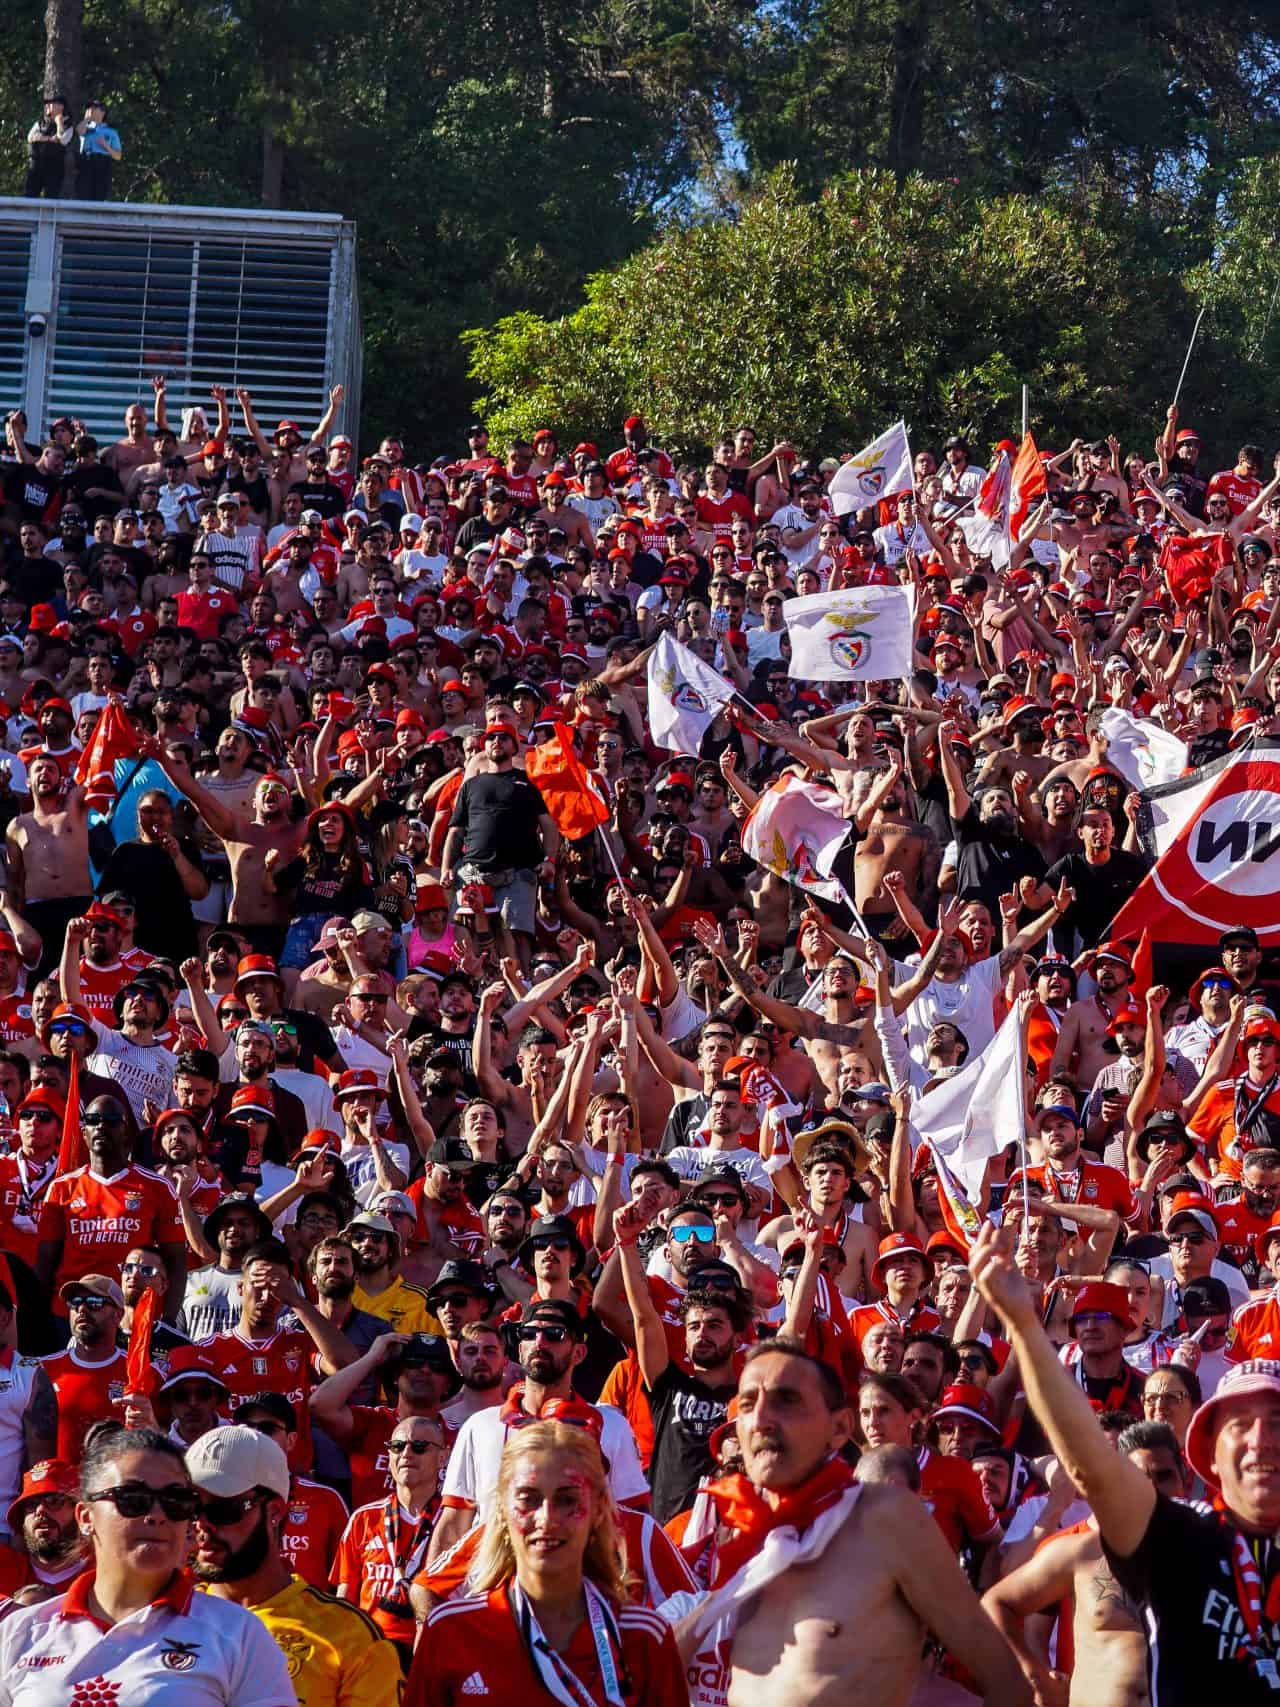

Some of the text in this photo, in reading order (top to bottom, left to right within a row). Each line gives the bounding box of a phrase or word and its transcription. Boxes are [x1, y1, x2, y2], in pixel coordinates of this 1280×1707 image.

[70, 1217, 142, 1235] Emirates
[79, 1227, 129, 1245] FLY BETTER
